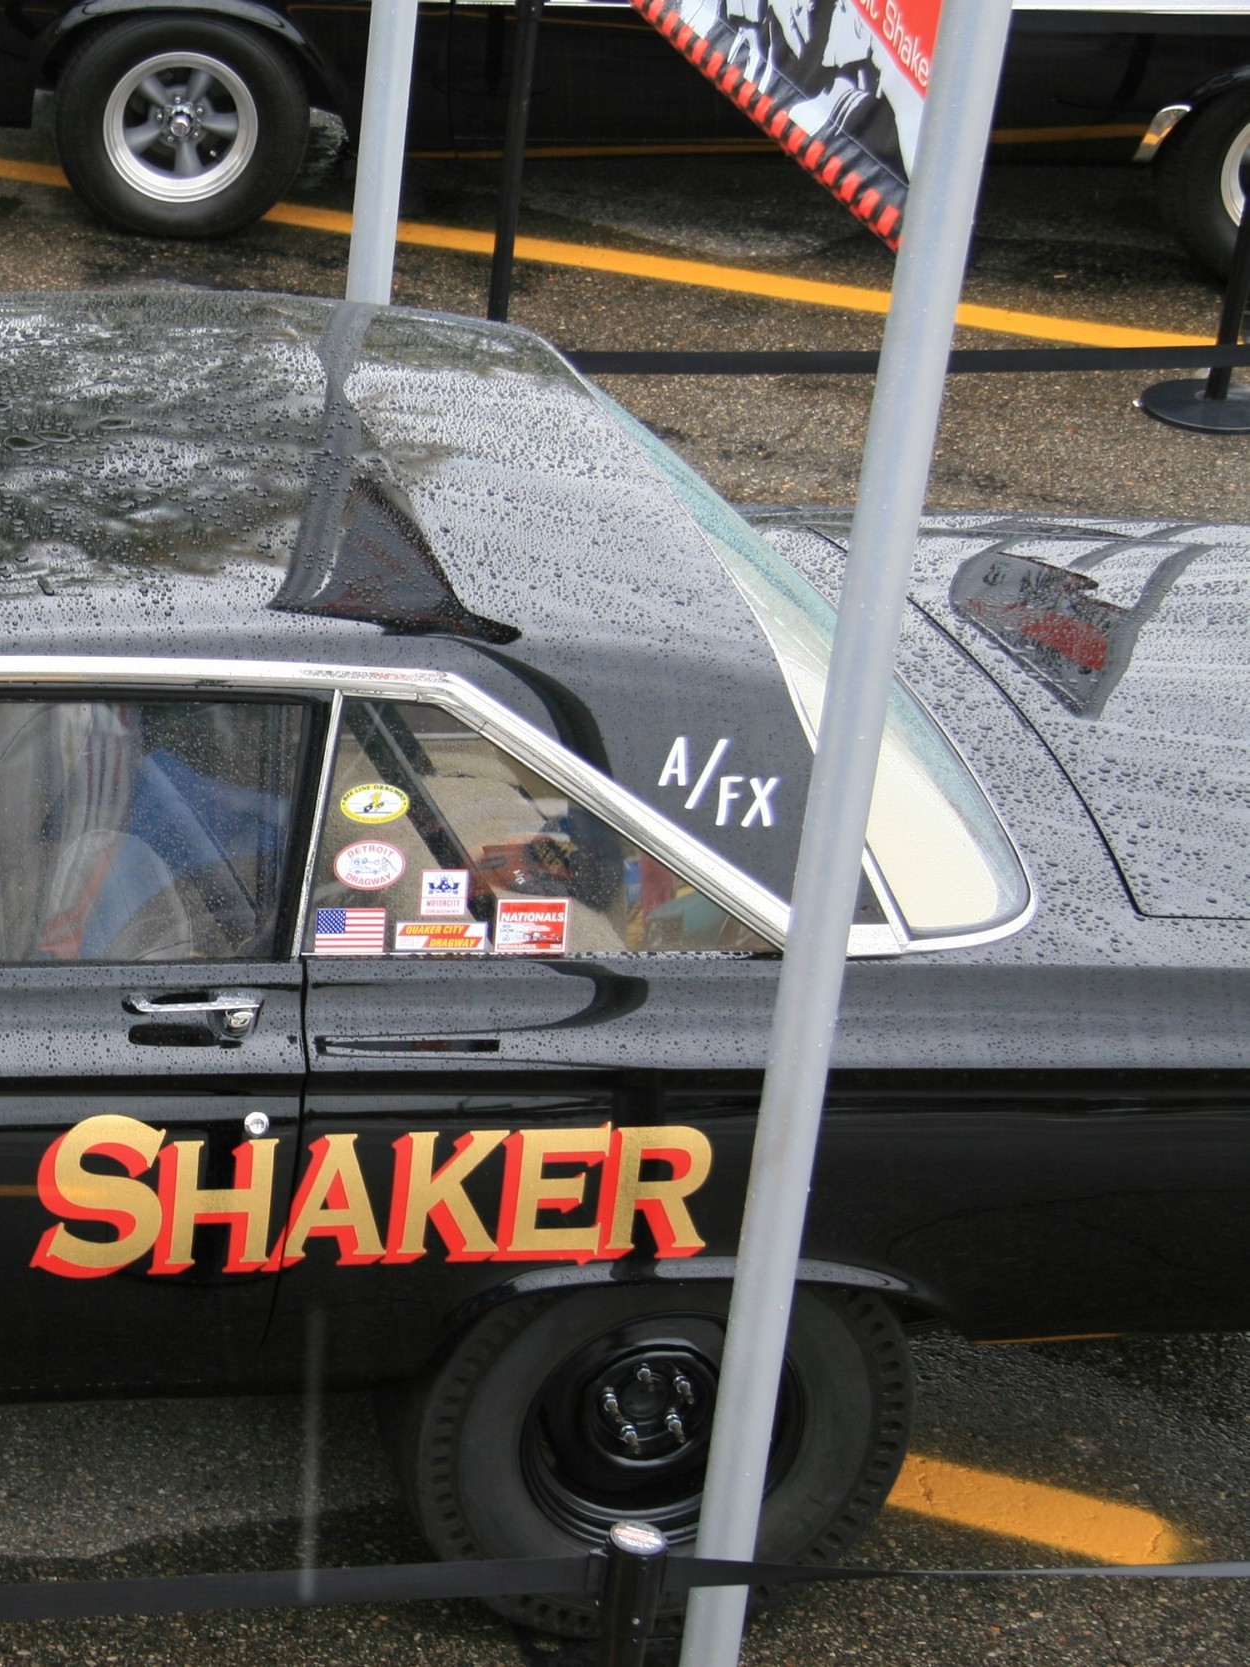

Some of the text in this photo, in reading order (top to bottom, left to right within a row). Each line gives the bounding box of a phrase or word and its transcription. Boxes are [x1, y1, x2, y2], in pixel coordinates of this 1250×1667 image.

[882, 0, 929, 88] Shake
[658, 736, 779, 827] A/FX
[355, 785, 370, 793] LINE
[373, 784, 406, 801] DRAGWAY
[347, 845, 395, 858] DETROIT
[345, 873, 391, 886] DRAGWAY
[501, 912, 564, 922] NATIONALS
[405, 925, 465, 934] QUAKER CITY
[429, 938, 476, 948] DRAGWAY
[29, 1113, 713, 1279] SHAKER
